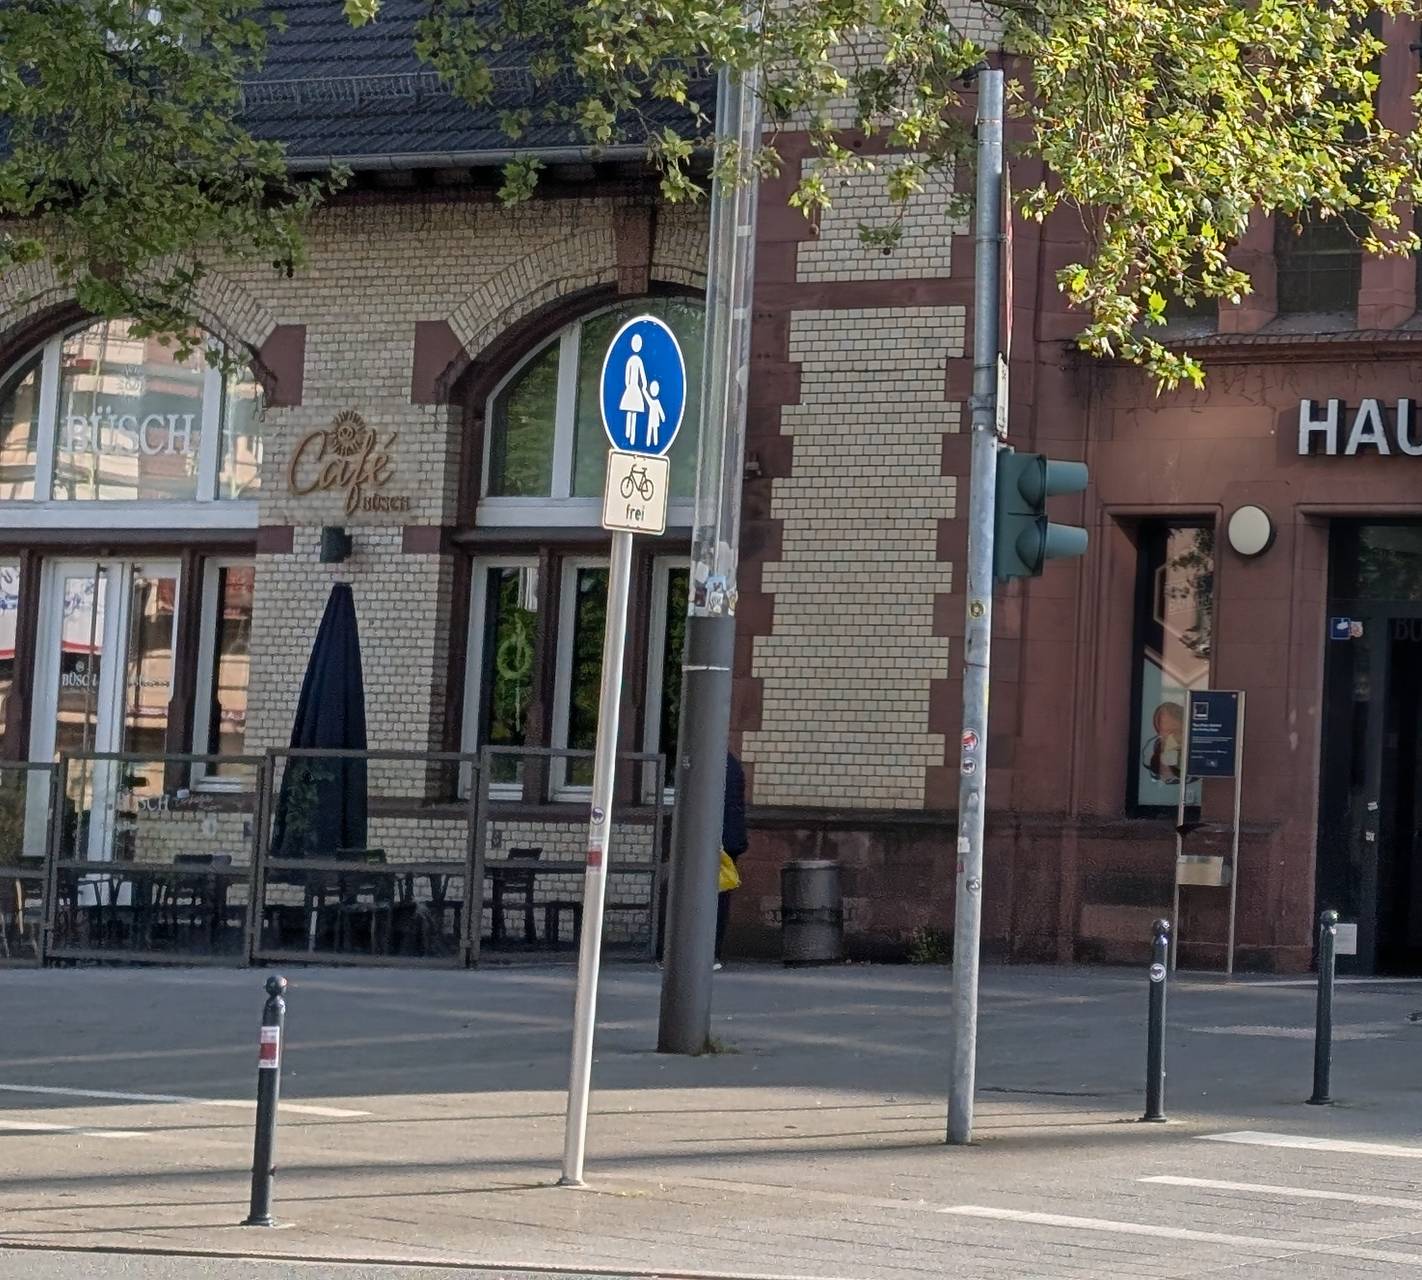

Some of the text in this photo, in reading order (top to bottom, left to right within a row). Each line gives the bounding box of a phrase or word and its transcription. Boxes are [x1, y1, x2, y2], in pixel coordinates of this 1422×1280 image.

[65, 405, 194, 455] BÜSCH
[287, 427, 397, 515] Café
[626, 503, 645, 521] frei
